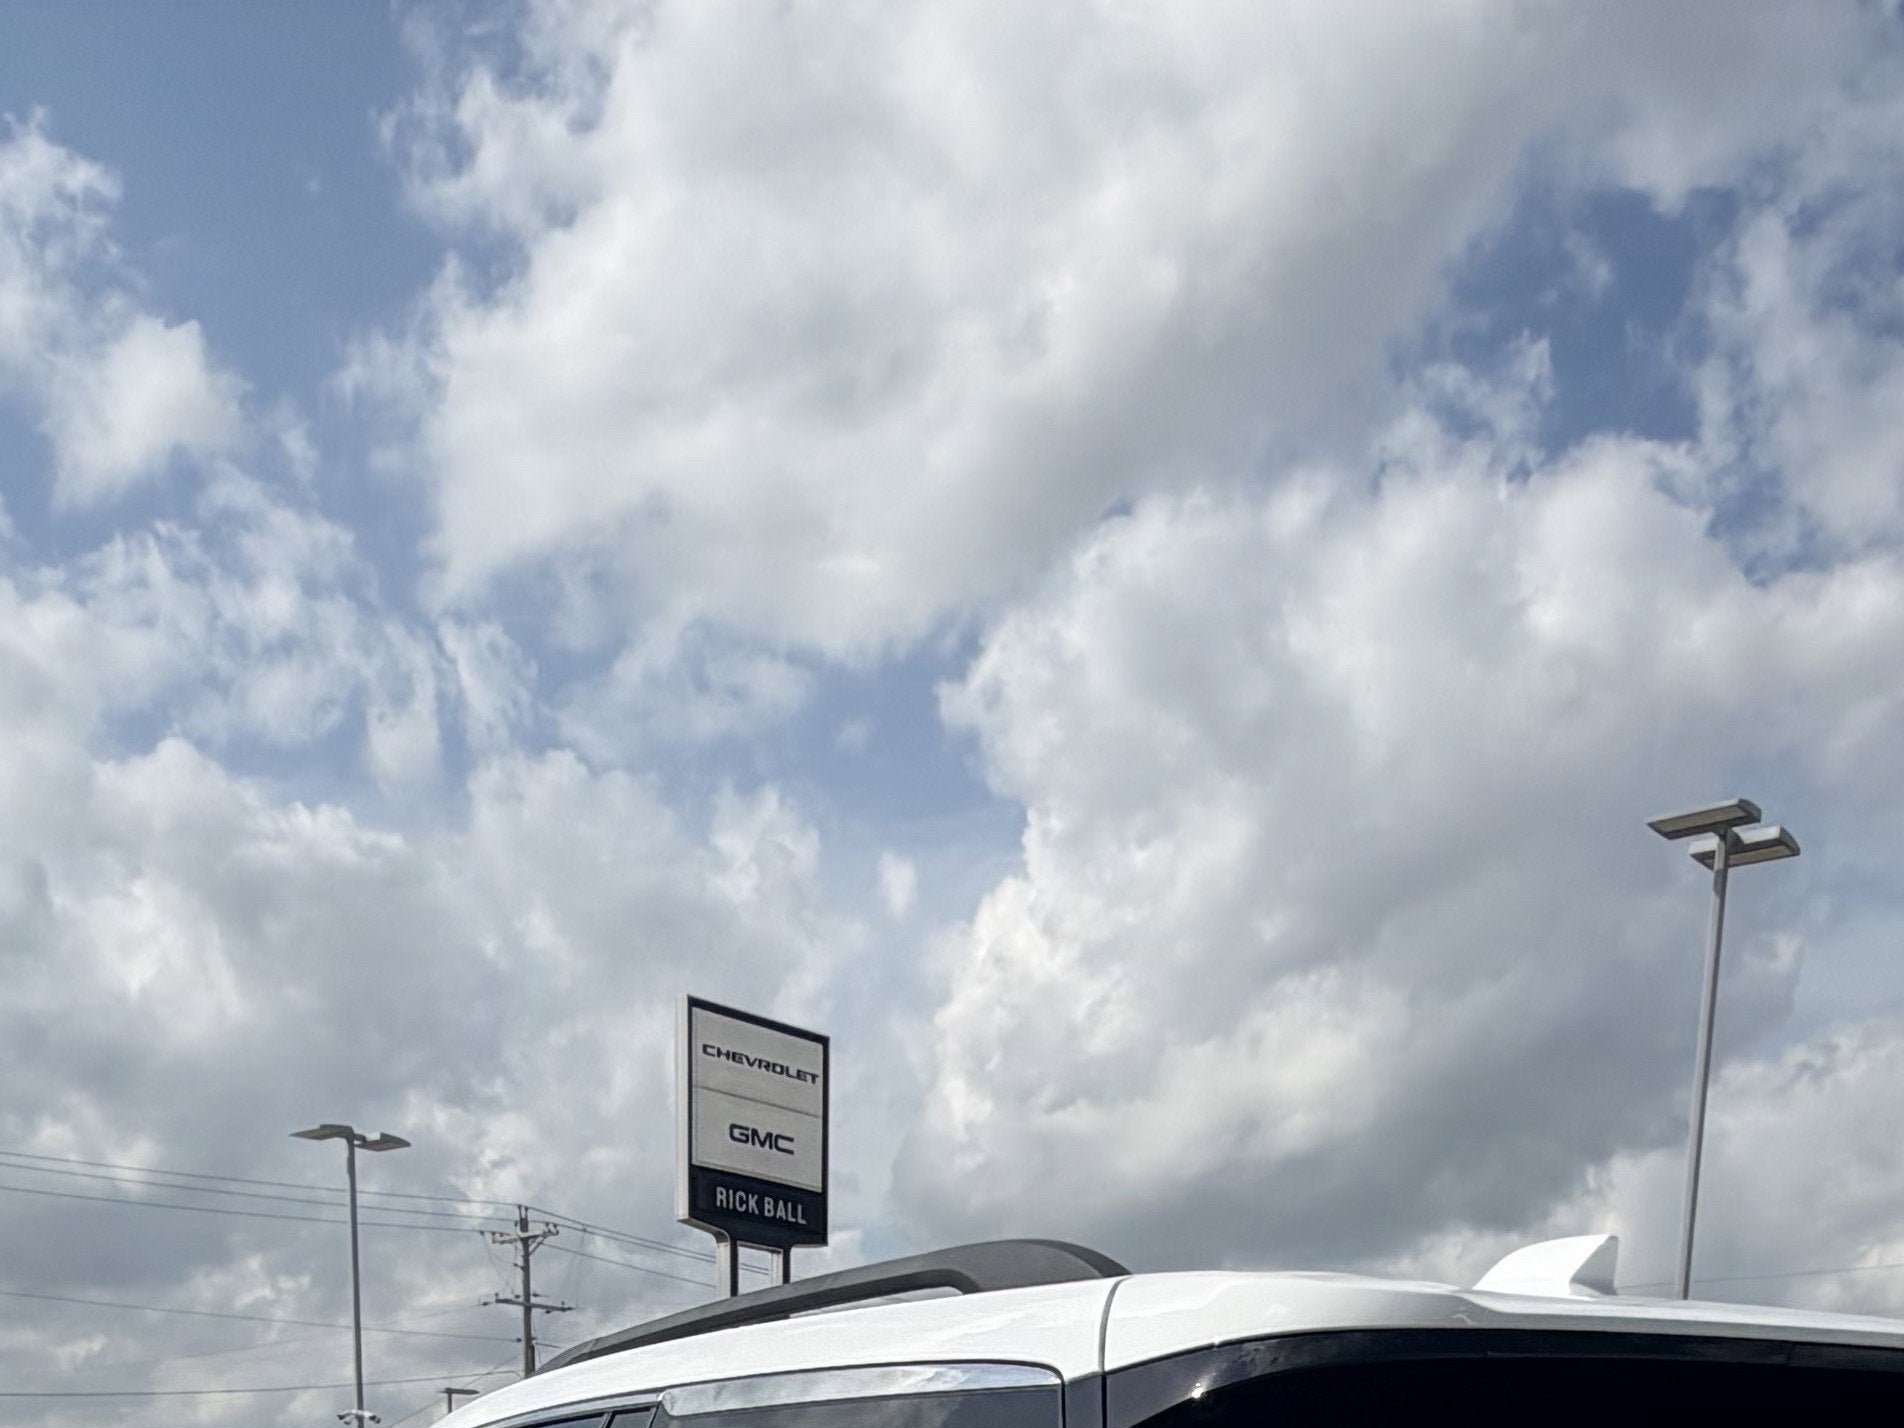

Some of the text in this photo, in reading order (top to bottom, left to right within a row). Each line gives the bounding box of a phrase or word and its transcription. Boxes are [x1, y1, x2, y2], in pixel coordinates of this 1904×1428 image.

[701, 1043, 819, 1085] CHEVROLET
[729, 1122, 795, 1155] GMC
[715, 1185, 807, 1225] RICK BALL
